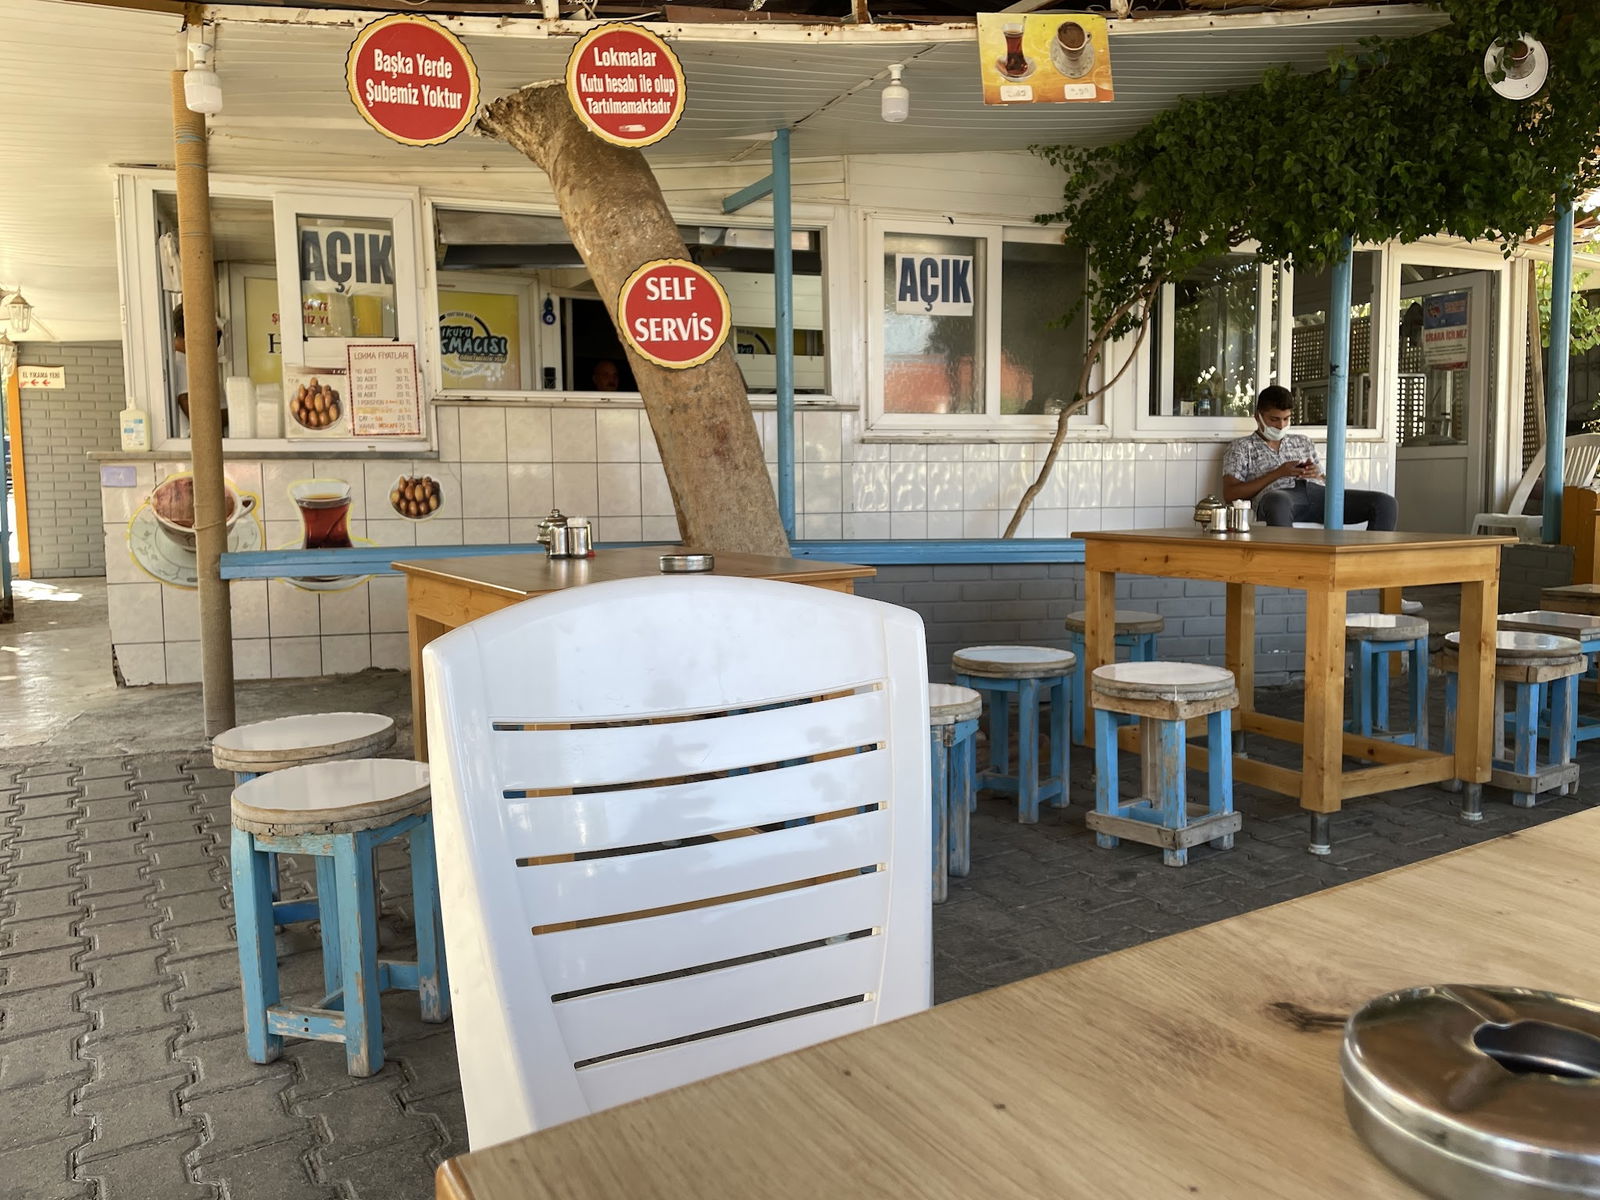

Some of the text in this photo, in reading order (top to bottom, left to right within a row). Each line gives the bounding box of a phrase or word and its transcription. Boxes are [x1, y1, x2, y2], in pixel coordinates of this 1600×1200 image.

[374, 48, 453, 79] Başka Yerde
[593, 46, 657, 67] Lokmalar
[365, 78, 462, 110] Şubemiz Yoktur
[580, 73, 676, 97] Kutu hesabı ile olup
[585, 97, 671, 115] Tartılmamaktadır
[301, 230, 394, 293] AÇIK
[645, 277, 696, 301] SELF
[898, 257, 972, 312] AÇIK
[634, 312, 714, 342] SERVİS
[354, 351, 377, 360] LOKMA
